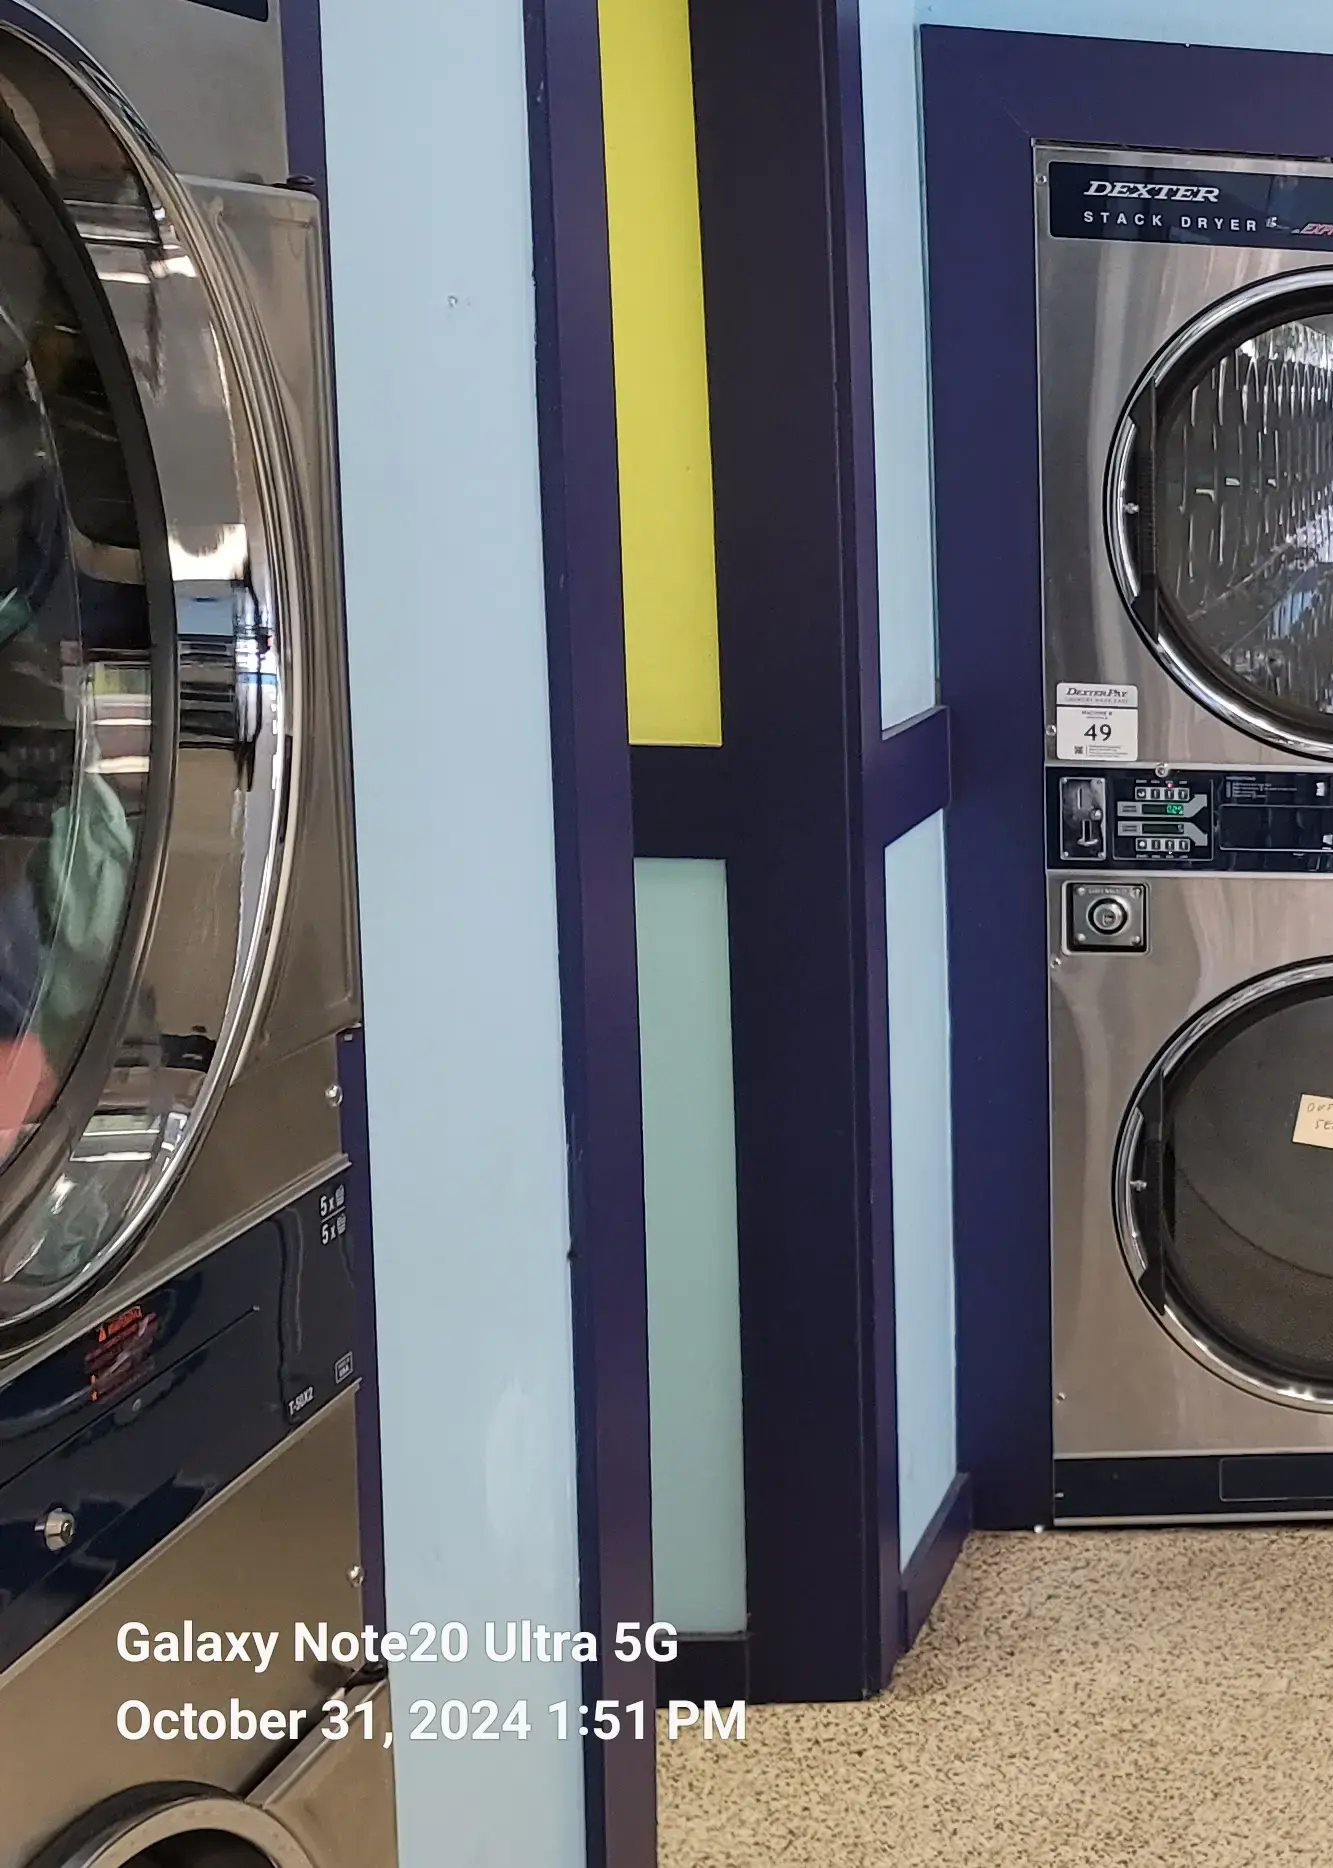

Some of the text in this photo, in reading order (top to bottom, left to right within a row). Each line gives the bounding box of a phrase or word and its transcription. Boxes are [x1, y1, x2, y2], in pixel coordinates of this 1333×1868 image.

[1083, 180, 1220, 203] DEXTER
[1083, 211, 1257, 232] STACK DRYER
[1083, 724, 1112, 742] 49
[319, 1196, 335, 1217] 5 x
[321, 1224, 337, 1245] 5 x
[288, 1385, 314, 1416] T-50X2
